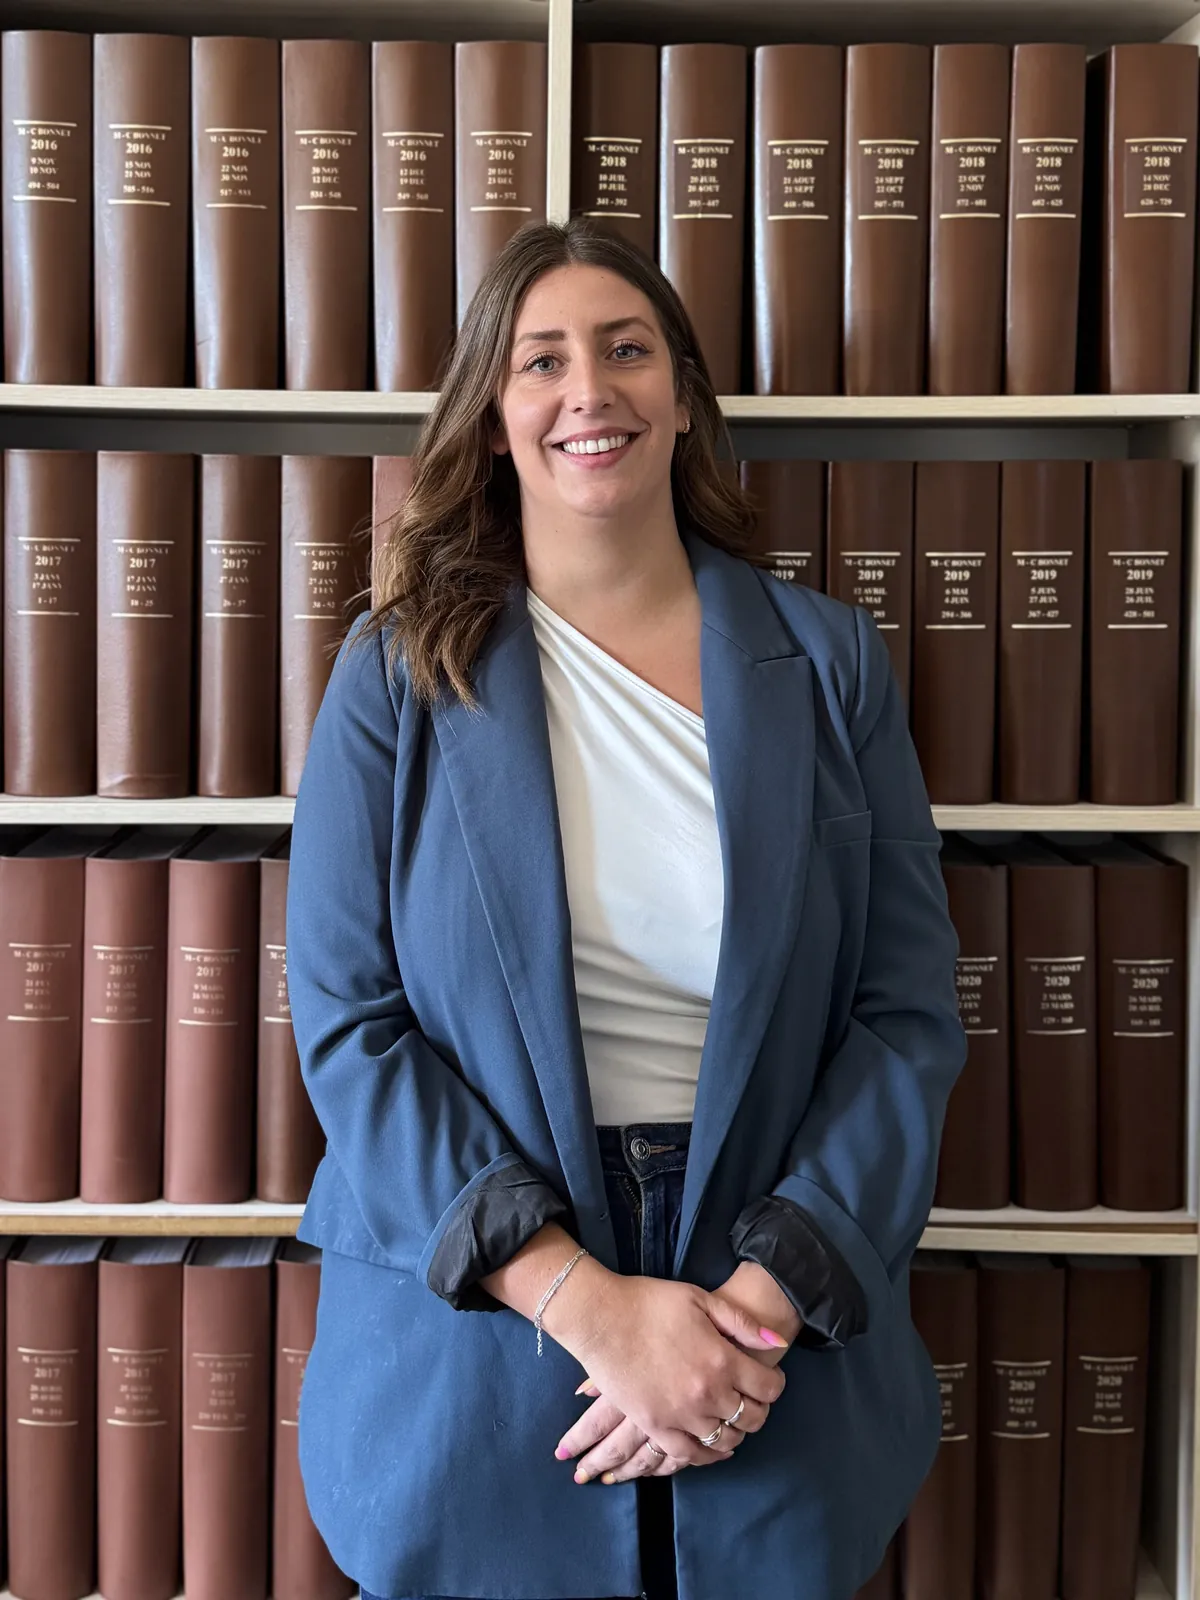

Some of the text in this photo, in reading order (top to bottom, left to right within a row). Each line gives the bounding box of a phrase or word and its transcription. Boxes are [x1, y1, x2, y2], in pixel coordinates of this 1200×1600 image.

[31, 139, 58, 150] 2016
[126, 143, 153, 154] 2016
[608, 145, 639, 154] BONNET
[698, 146, 729, 154] BONNET
[967, 146, 997, 154] BONNET
[1044, 146, 1074, 154] BONNET
[223, 146, 249, 157] 2016
[312, 148, 339, 160] 2016
[400, 150, 427, 161] 2016
[489, 150, 515, 161] 2016
[794, 147, 825, 155] BONNET
[885, 147, 915, 155] BONNET
[601, 156, 627, 167] 2018
[692, 158, 718, 169] 2018
[787, 158, 813, 169] 2018
[878, 158, 903, 169] 2018
[960, 157, 985, 168] 2018
[1036, 157, 1062, 168] 2018
[1144, 156, 1171, 167] 2018
[35, 555, 61, 566] 2017
[129, 557, 156, 569] 2017
[222, 558, 249, 569] 2017
[312, 560, 338, 571] 2017
[951, 559, 982, 567] BONNET
[858, 569, 884, 580] 2019
[944, 570, 971, 581] 2019
[1031, 569, 1057, 580] 2019
[1127, 569, 1154, 580] 2019
[26, 962, 53, 972] 2017
[109, 964, 136, 975] 2017
[196, 966, 222, 977] 2017
[956, 975, 982, 987] 2020
[1045, 976, 1071, 987] 2020
[1133, 978, 1159, 989] 2020
[35, 1368, 60, 1378] 2017
[1009, 1380, 1036, 1391] 2020
[1097, 1375, 1123, 1386] 2020
